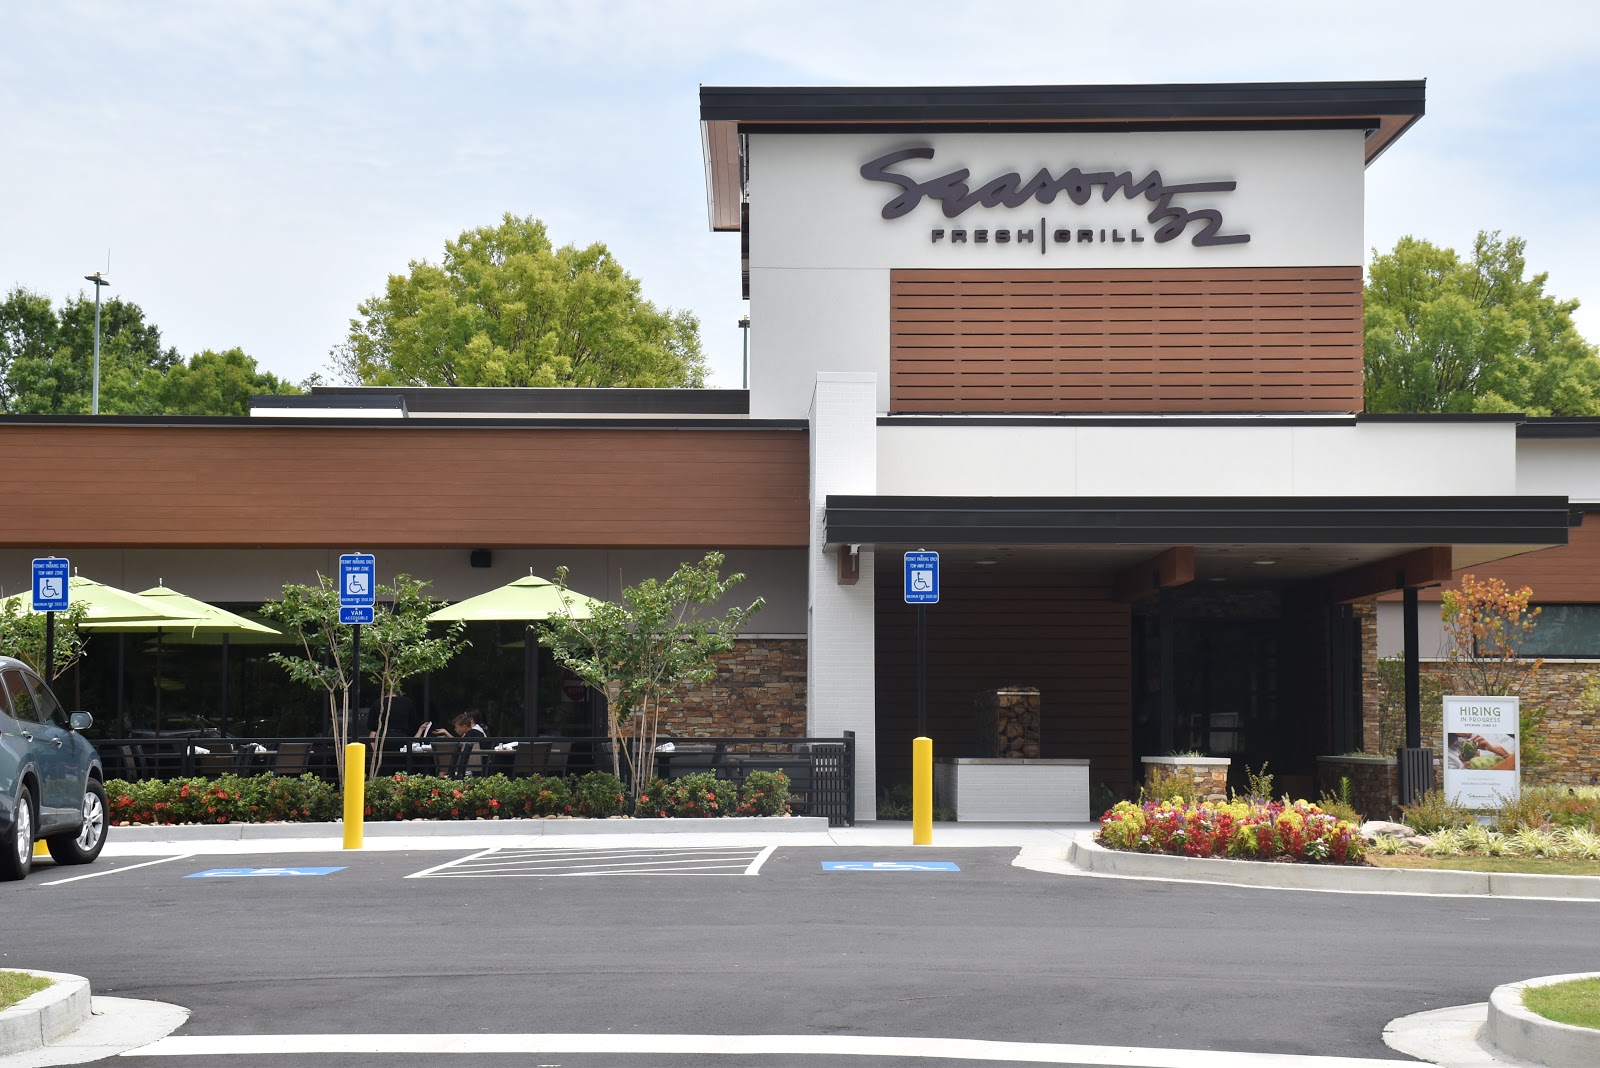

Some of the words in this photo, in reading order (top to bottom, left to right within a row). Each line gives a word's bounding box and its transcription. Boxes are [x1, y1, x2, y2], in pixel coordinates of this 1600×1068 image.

[860, 147, 1165, 219] Seasons
[1147, 181, 1251, 247] 52
[931, 229, 1034, 244] FRESH
[1053, 228, 1145, 243] GRILL
[1460, 706, 1500, 716] HIRING
